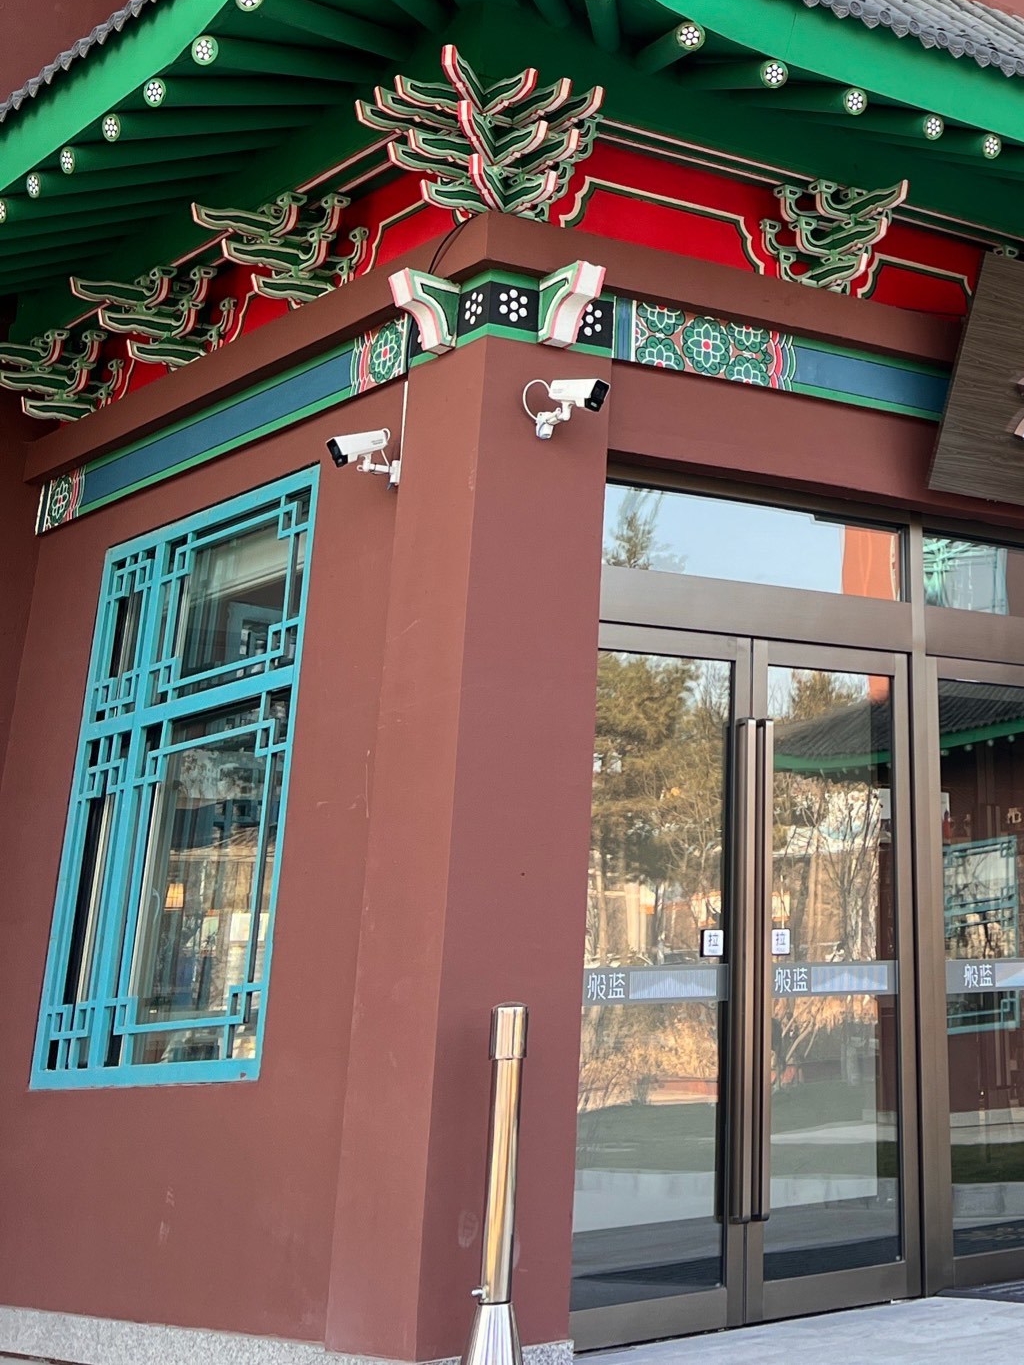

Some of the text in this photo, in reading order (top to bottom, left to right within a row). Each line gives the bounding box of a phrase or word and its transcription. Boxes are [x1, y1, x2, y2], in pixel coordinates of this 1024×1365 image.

[708, 932, 719, 947] 拉
[776, 931, 786, 946] 拉
[587, 973, 626, 1001] 般蓝
[774, 967, 809, 993] 般蓝
[963, 963, 994, 988] 般蓝
